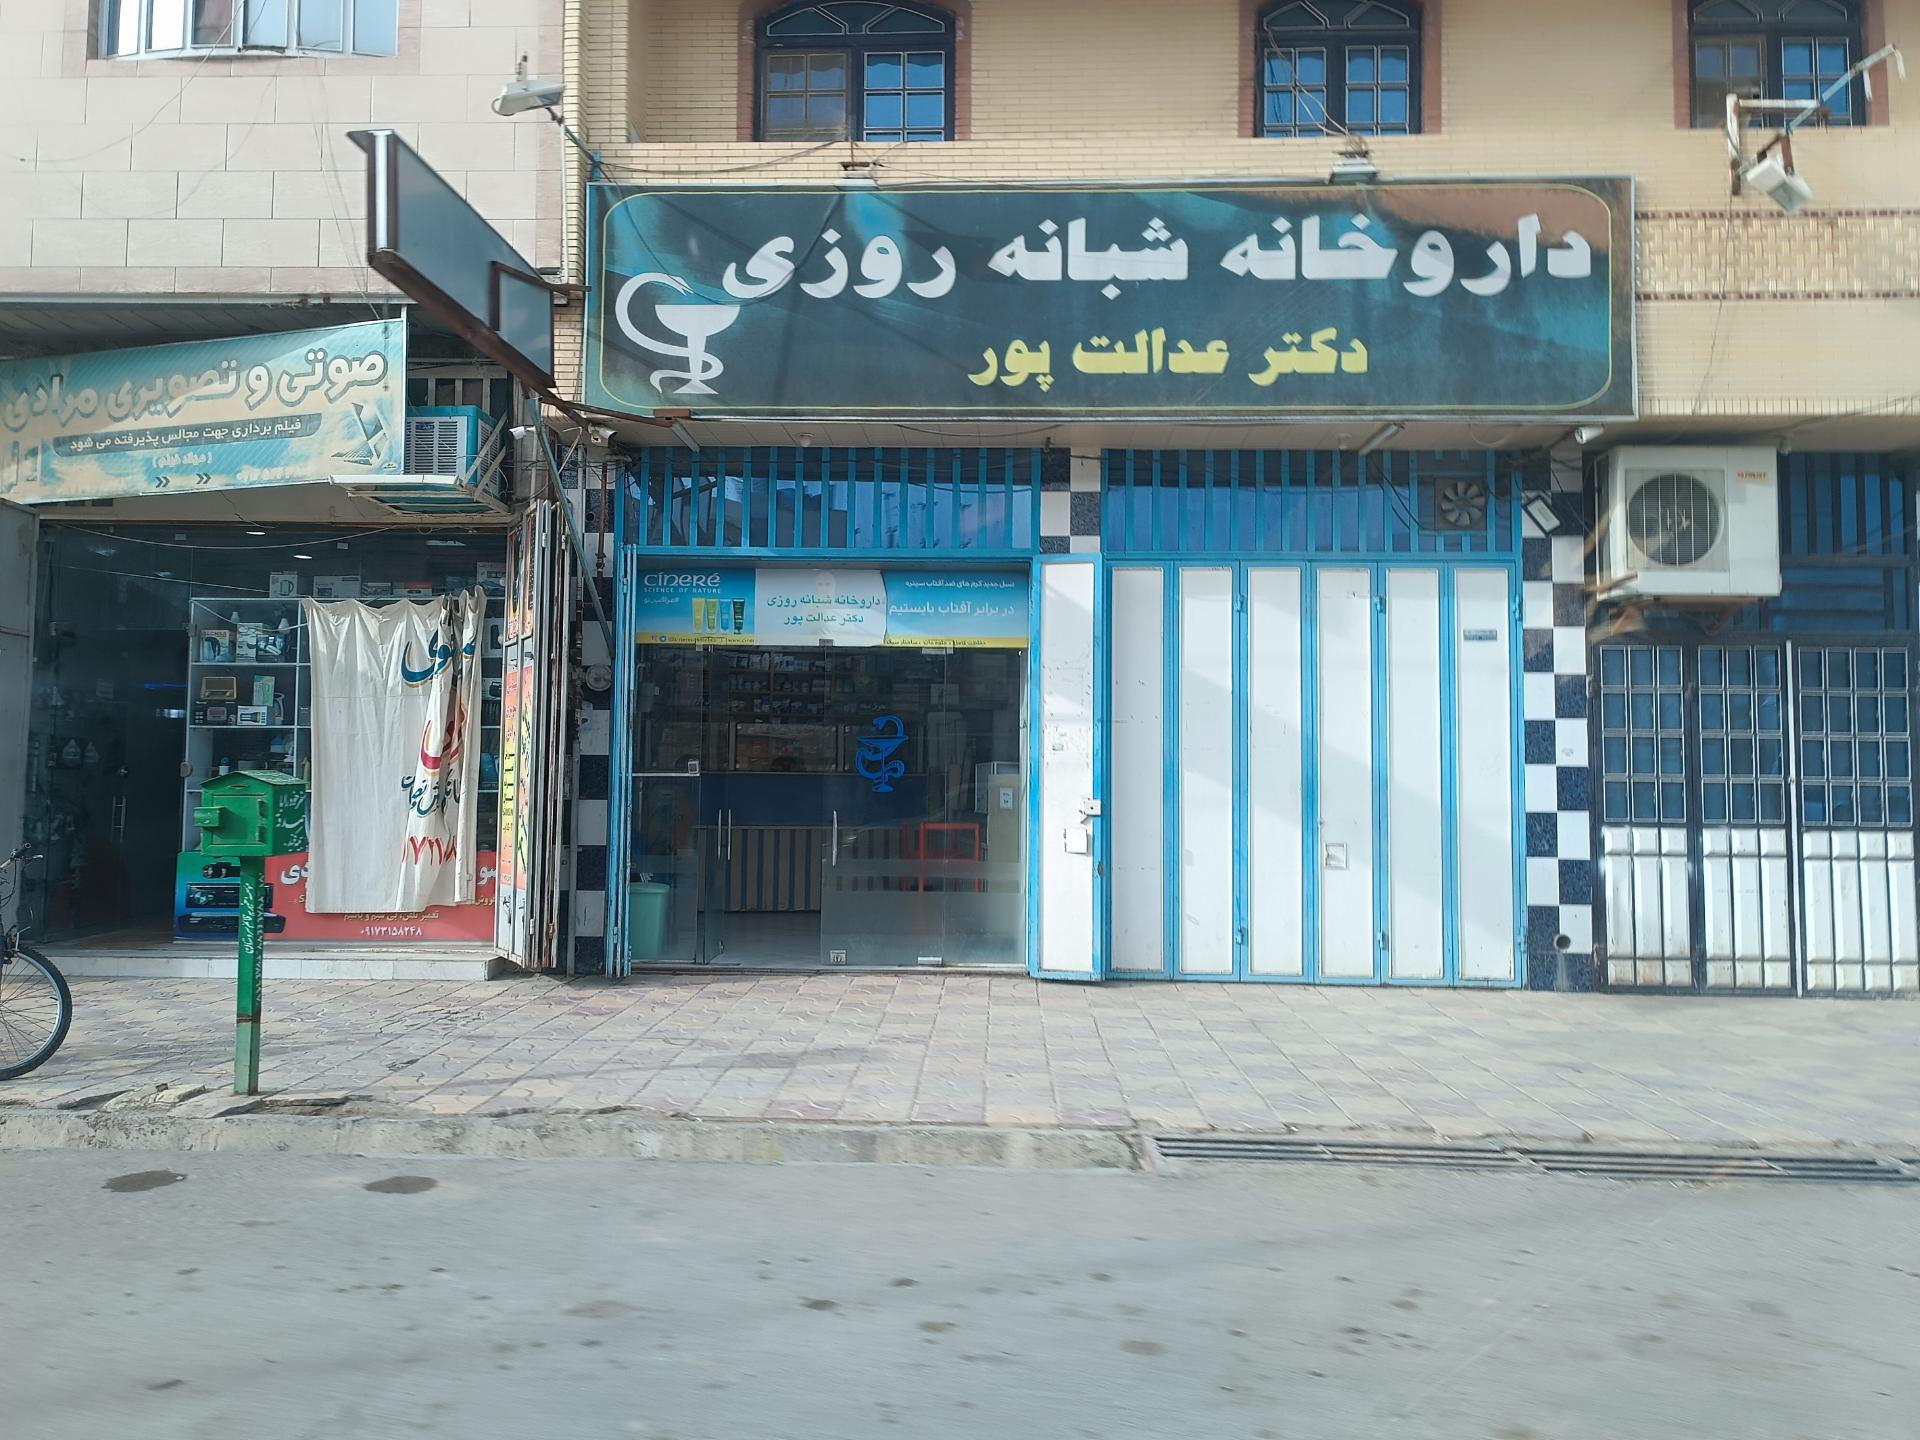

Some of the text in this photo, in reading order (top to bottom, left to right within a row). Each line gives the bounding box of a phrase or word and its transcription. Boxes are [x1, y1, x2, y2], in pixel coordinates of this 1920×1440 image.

[722, 212, 1592, 300] داروخانه شبانه روزی
[278, 348, 388, 404] صوتی
[968, 327, 1369, 392] دکتر عدالت پور
[106, 359, 241, 422] تصویری
[248, 364, 273, 410] و
[69, 418, 302, 452] فیلم برداری جهت مجالس پذیرفته می شود
[767, 595, 881, 609] داروخانه شبانه روزی
[938, 600, 971, 616] آفتاب
[975, 601, 999, 617] برابر
[1002, 605, 1015, 616] در
[783, 612, 864, 627] دکتر عدالت پور
